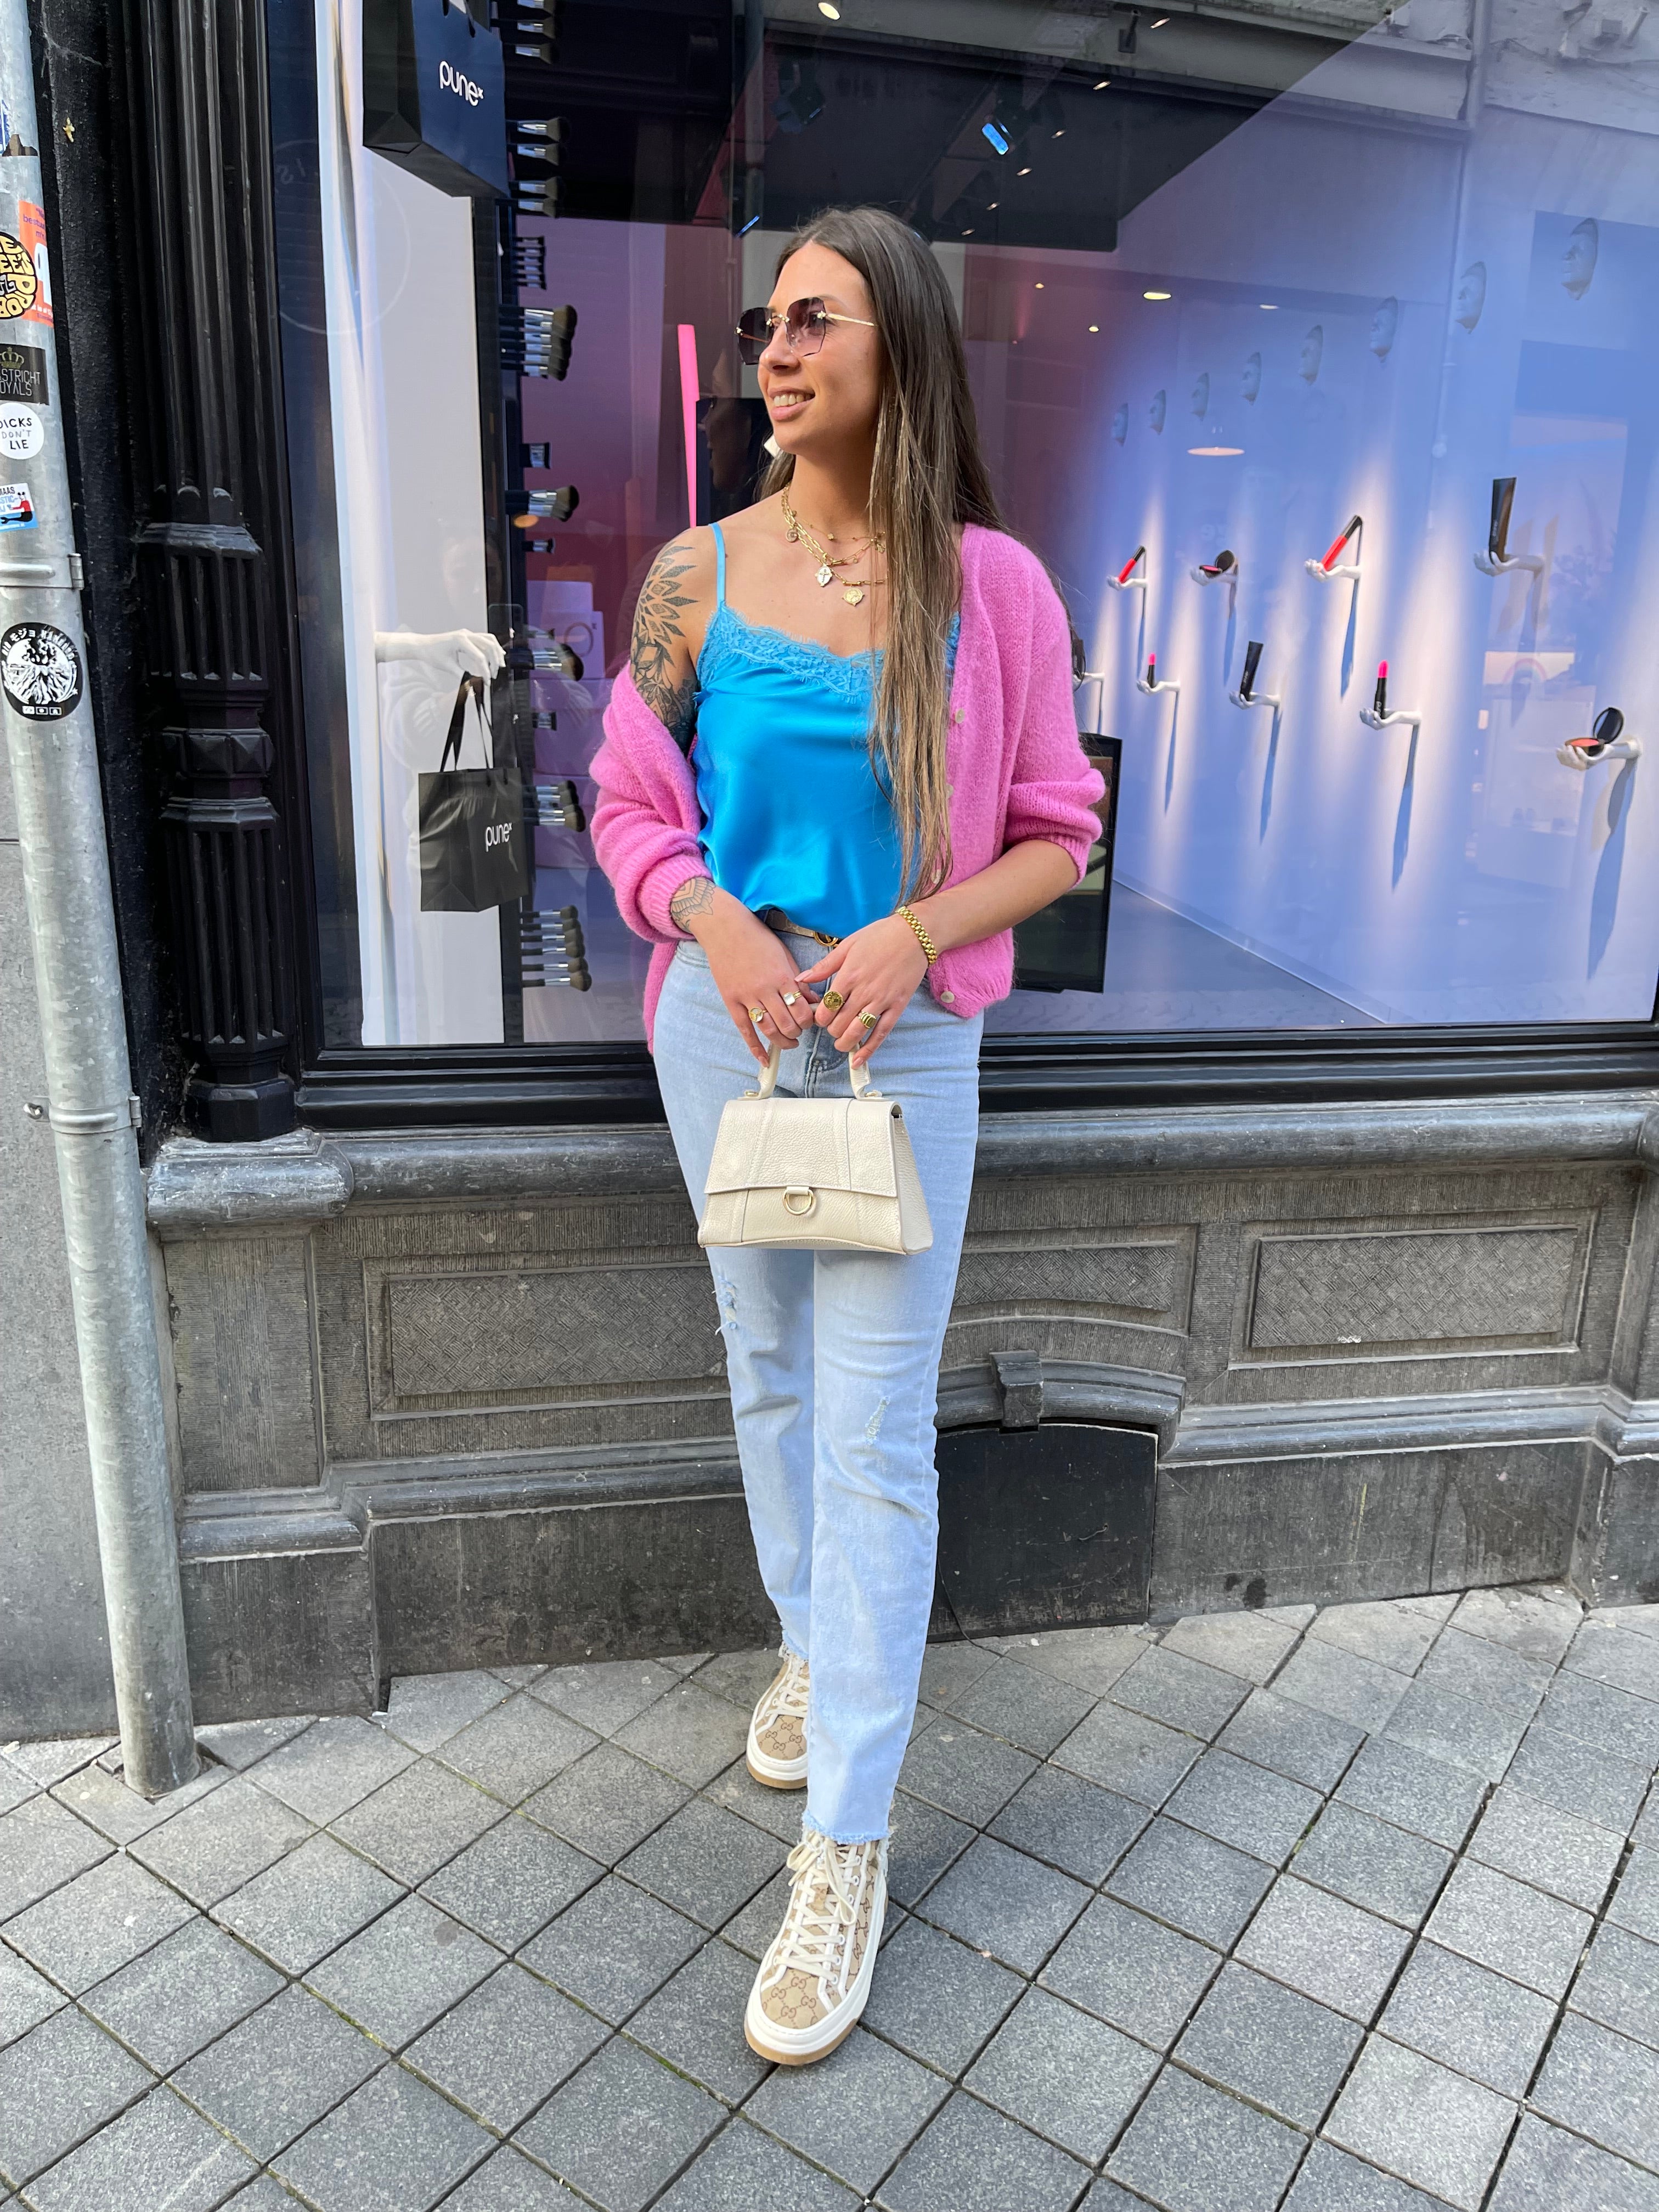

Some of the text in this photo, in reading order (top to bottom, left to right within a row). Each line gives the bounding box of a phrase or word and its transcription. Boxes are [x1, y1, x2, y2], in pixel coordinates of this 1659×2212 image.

[0, 368, 41, 385] STRICHT
[2, 429, 31, 439] DON'T
[10, 439, 29, 450] LIE
